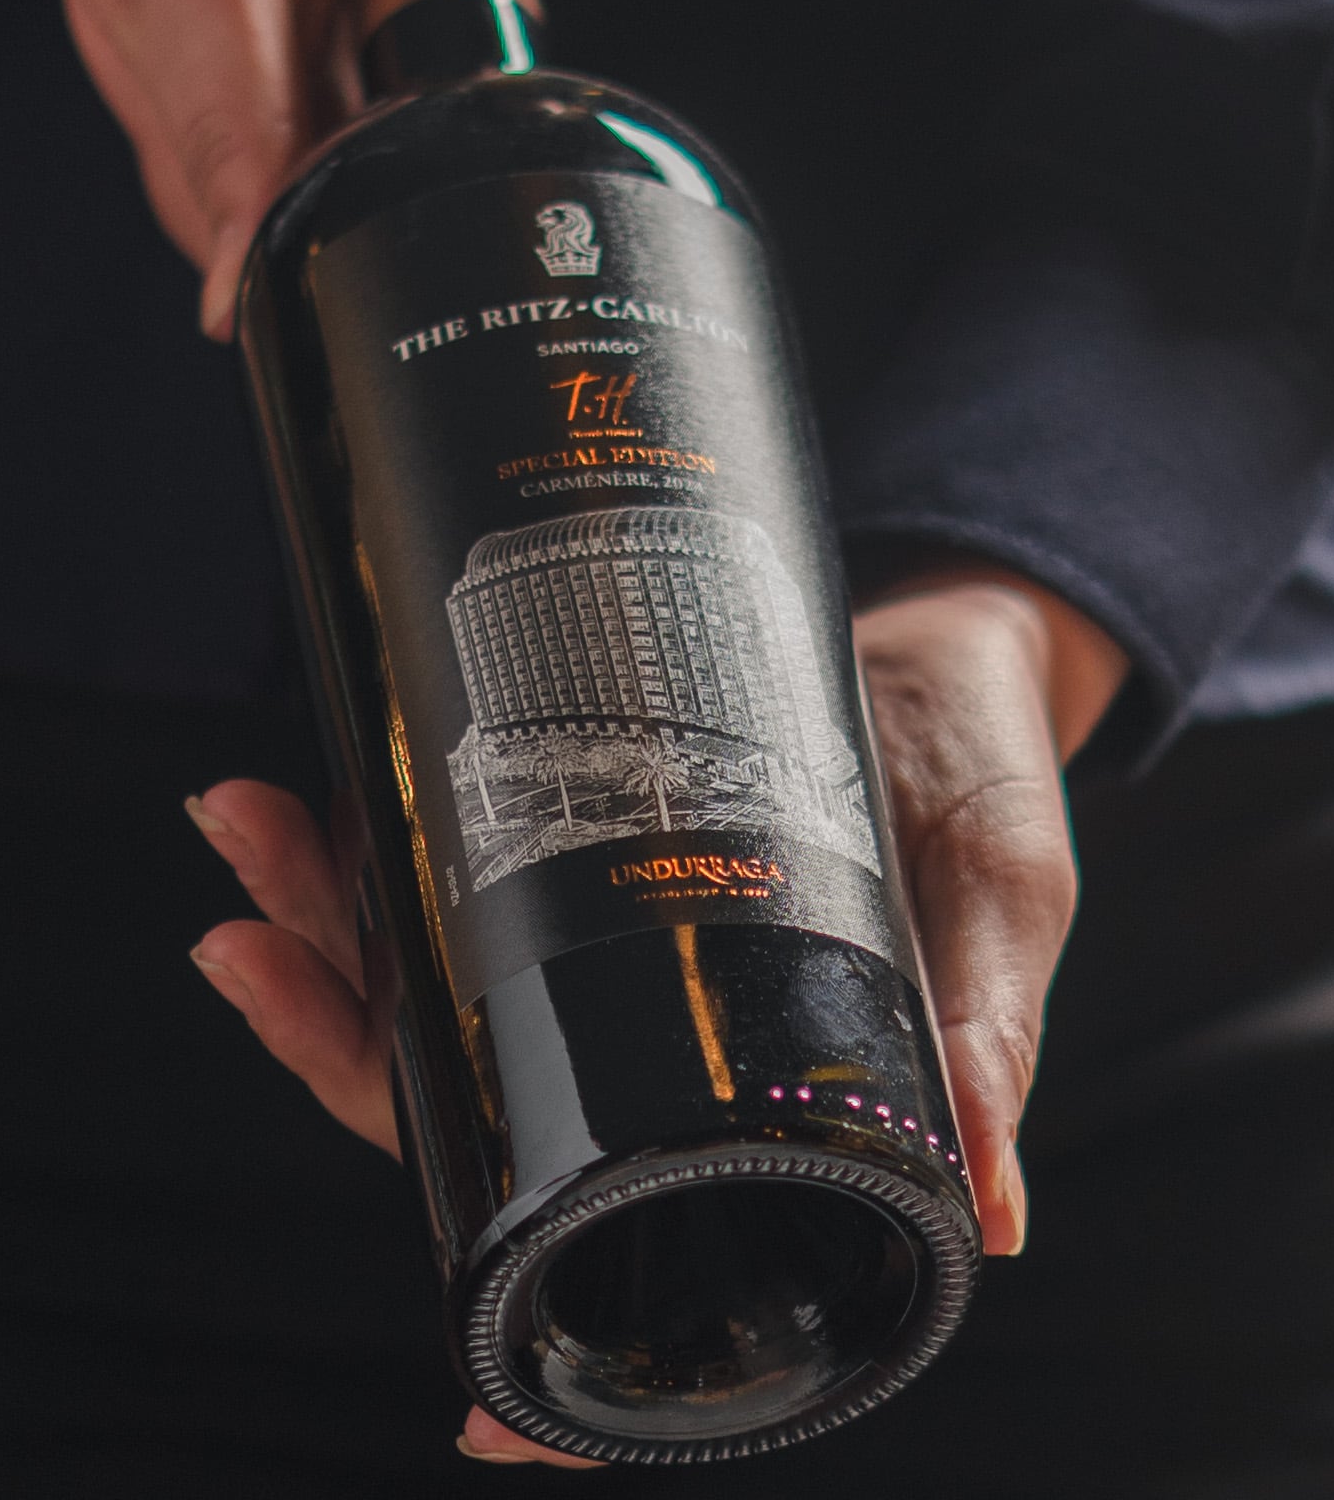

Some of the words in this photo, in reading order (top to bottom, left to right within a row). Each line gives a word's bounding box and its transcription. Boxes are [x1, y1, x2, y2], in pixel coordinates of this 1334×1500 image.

[391, 317, 468, 362] THE
[537, 340, 640, 357] SANTIAGO
[497, 447, 607, 480] SPECIAL
[611, 446, 716, 476] EDITION
[520, 470, 658, 498] CARMÉNÈRE,
[610, 856, 785, 886] UNDURRAGA
